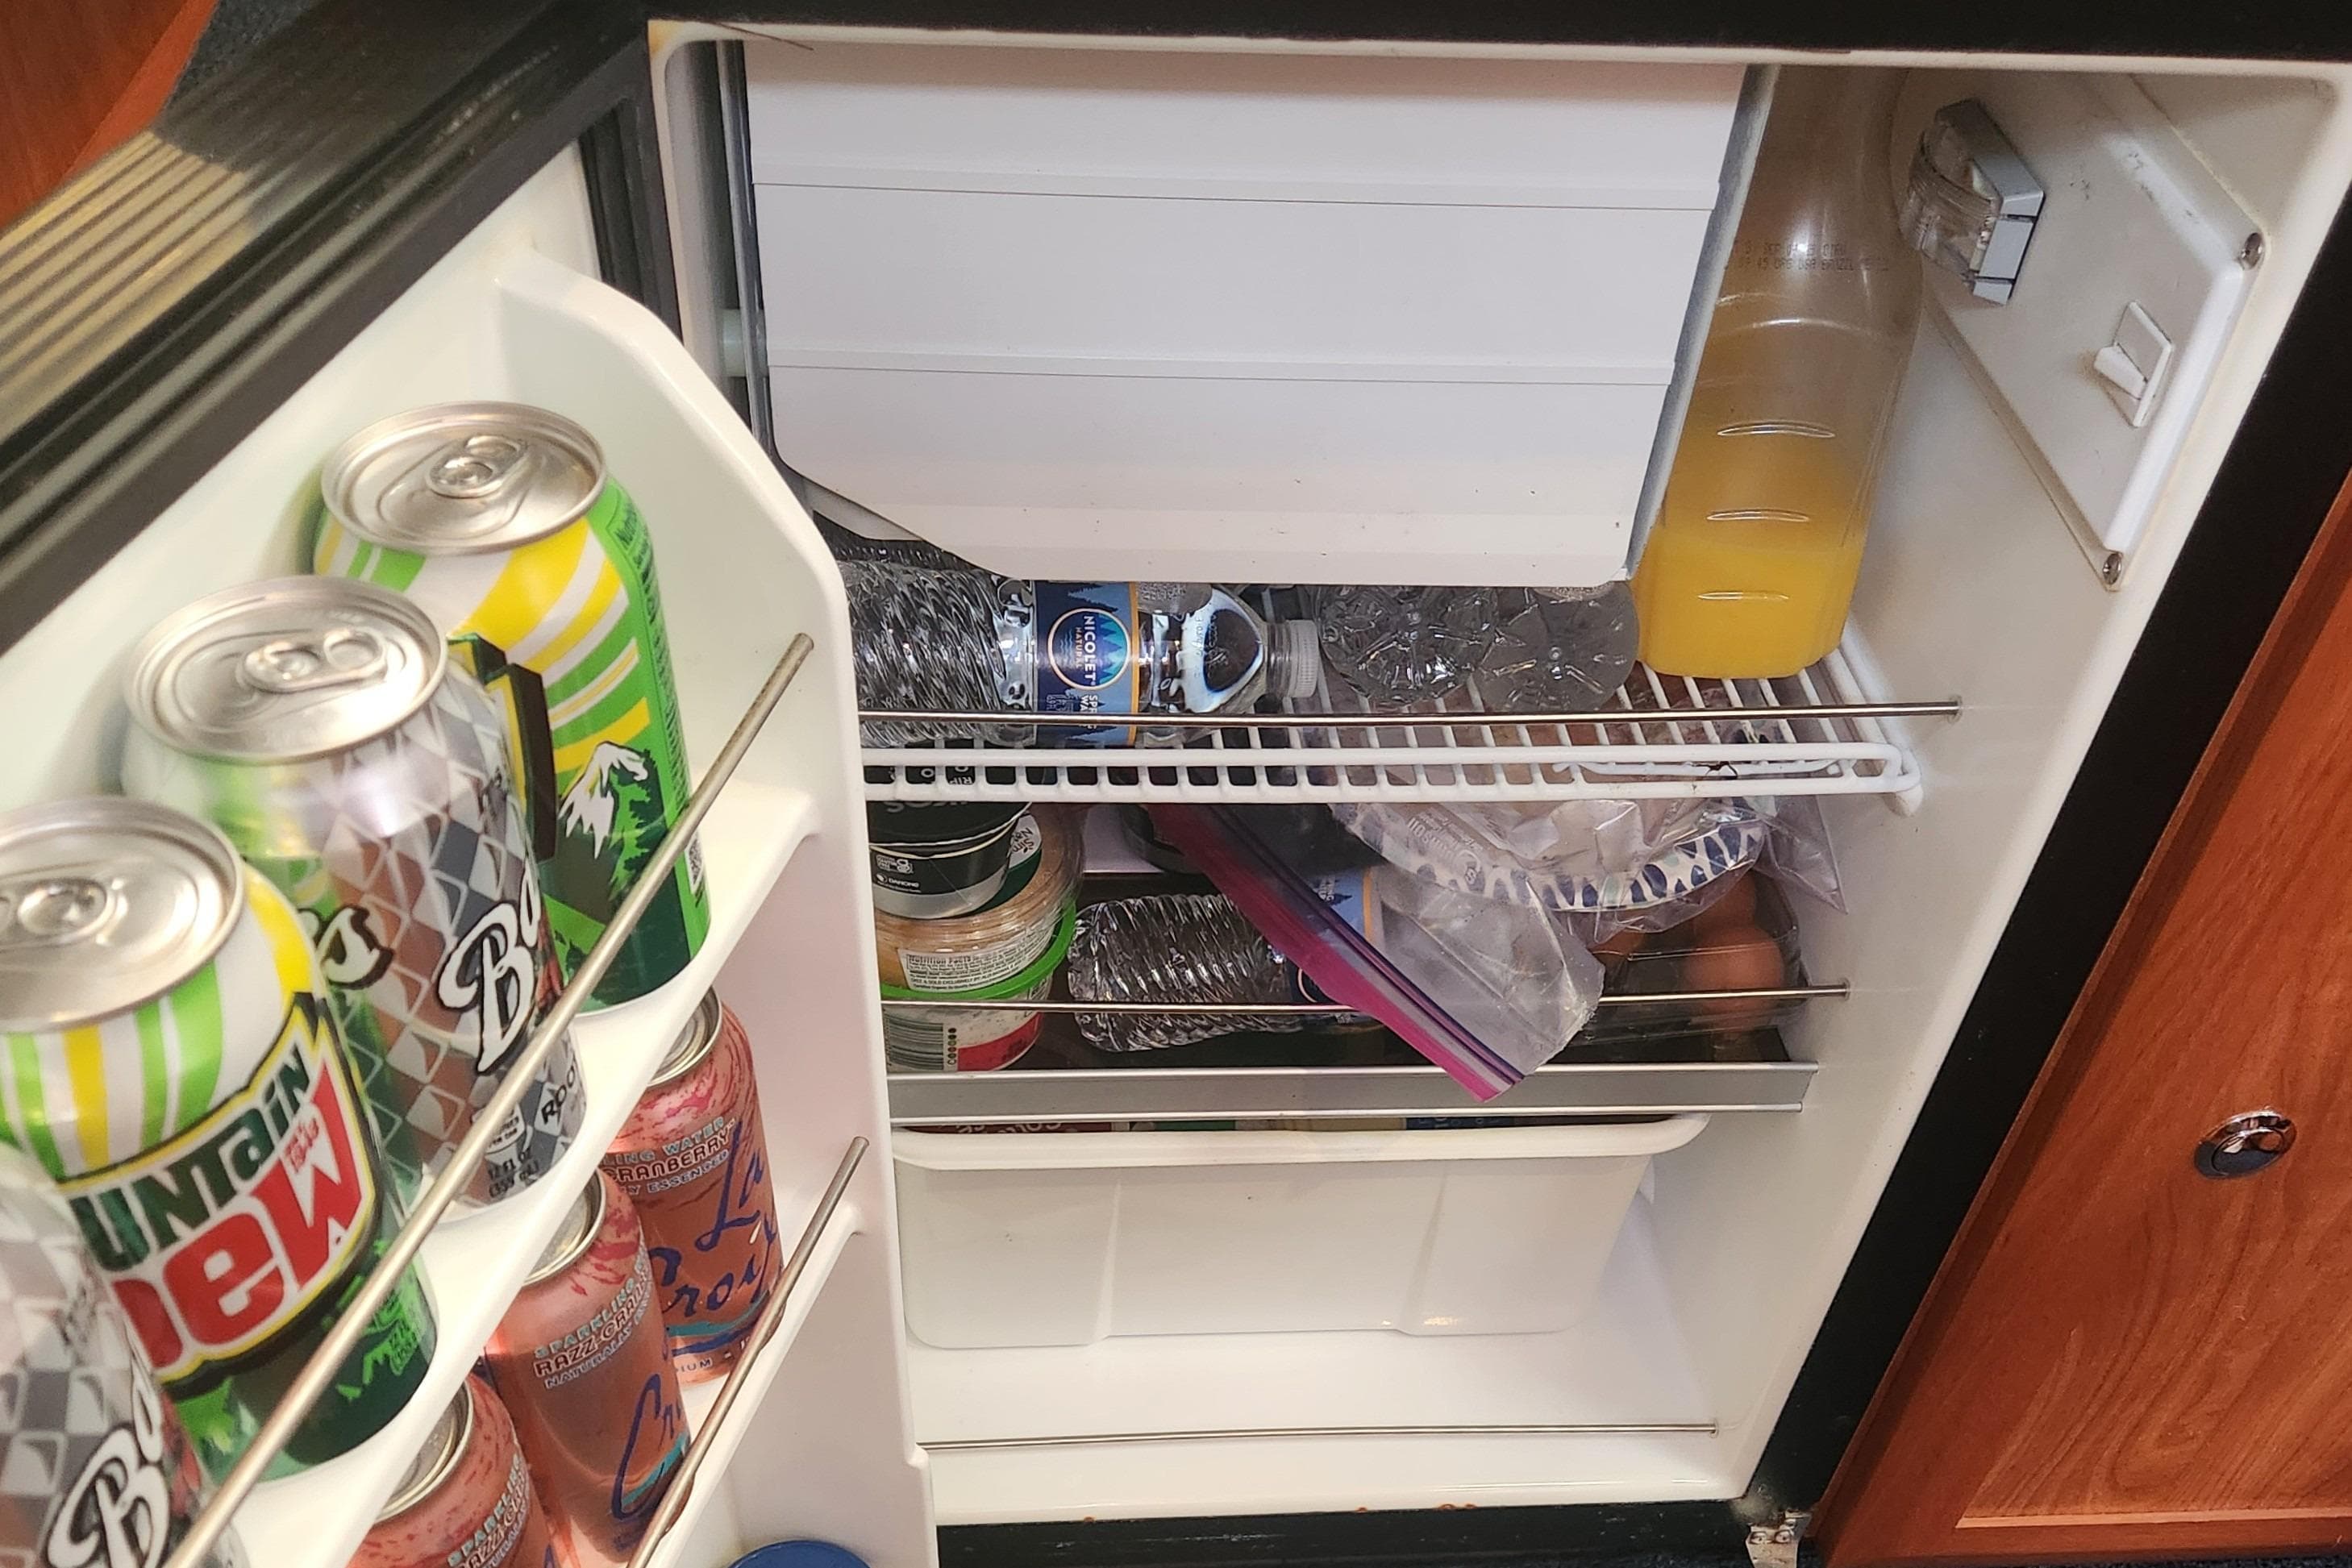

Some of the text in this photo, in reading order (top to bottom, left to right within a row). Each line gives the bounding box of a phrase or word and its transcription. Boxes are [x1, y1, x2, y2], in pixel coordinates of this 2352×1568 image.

[1084, 615, 1097, 685] NICOLET
[603, 1117, 725, 1166] LING WATER
[534, 1277, 635, 1359] SPARKLING
